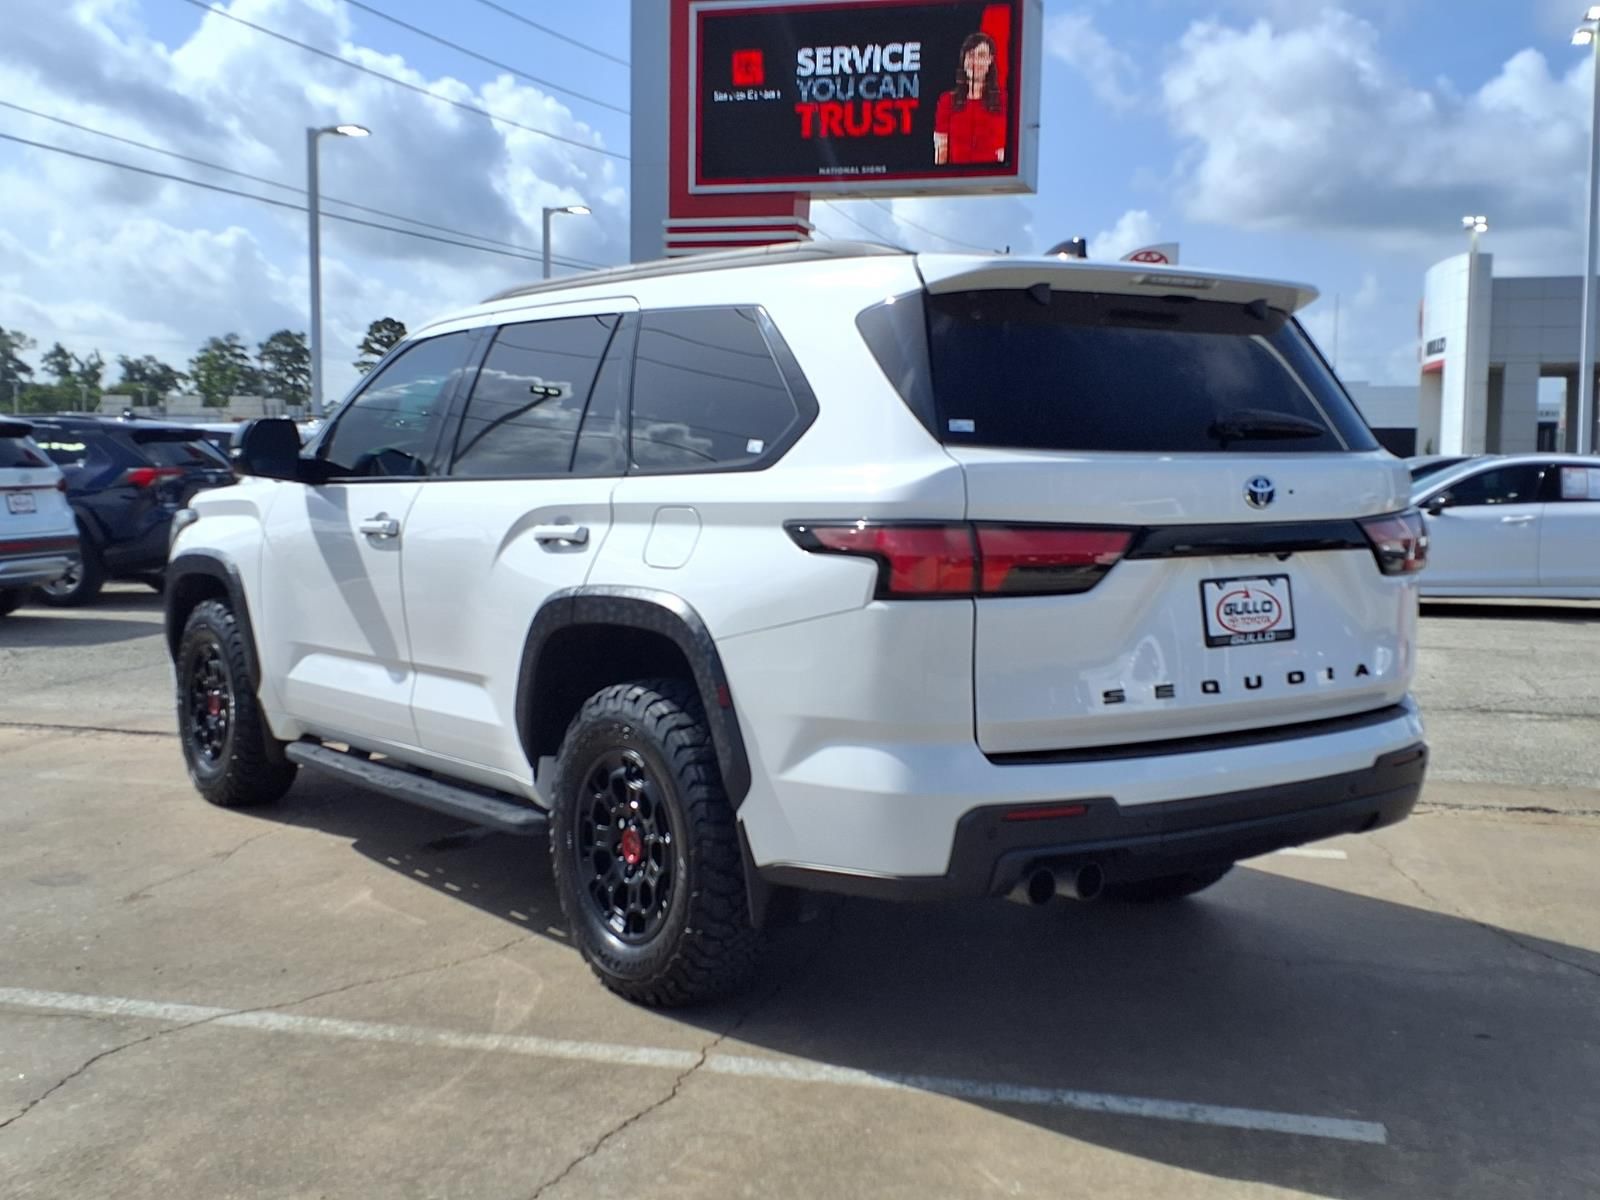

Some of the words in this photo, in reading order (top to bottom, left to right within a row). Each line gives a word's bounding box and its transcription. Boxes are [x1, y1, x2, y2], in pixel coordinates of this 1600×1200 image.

[796, 42, 921, 77] SERVICE
[796, 76, 854, 103] YOU
[859, 73, 919, 100] CAN
[795, 98, 919, 139] TRUST
[1223, 600, 1273, 616] GULLO
[1103, 663, 1369, 704] SEQUOIA
